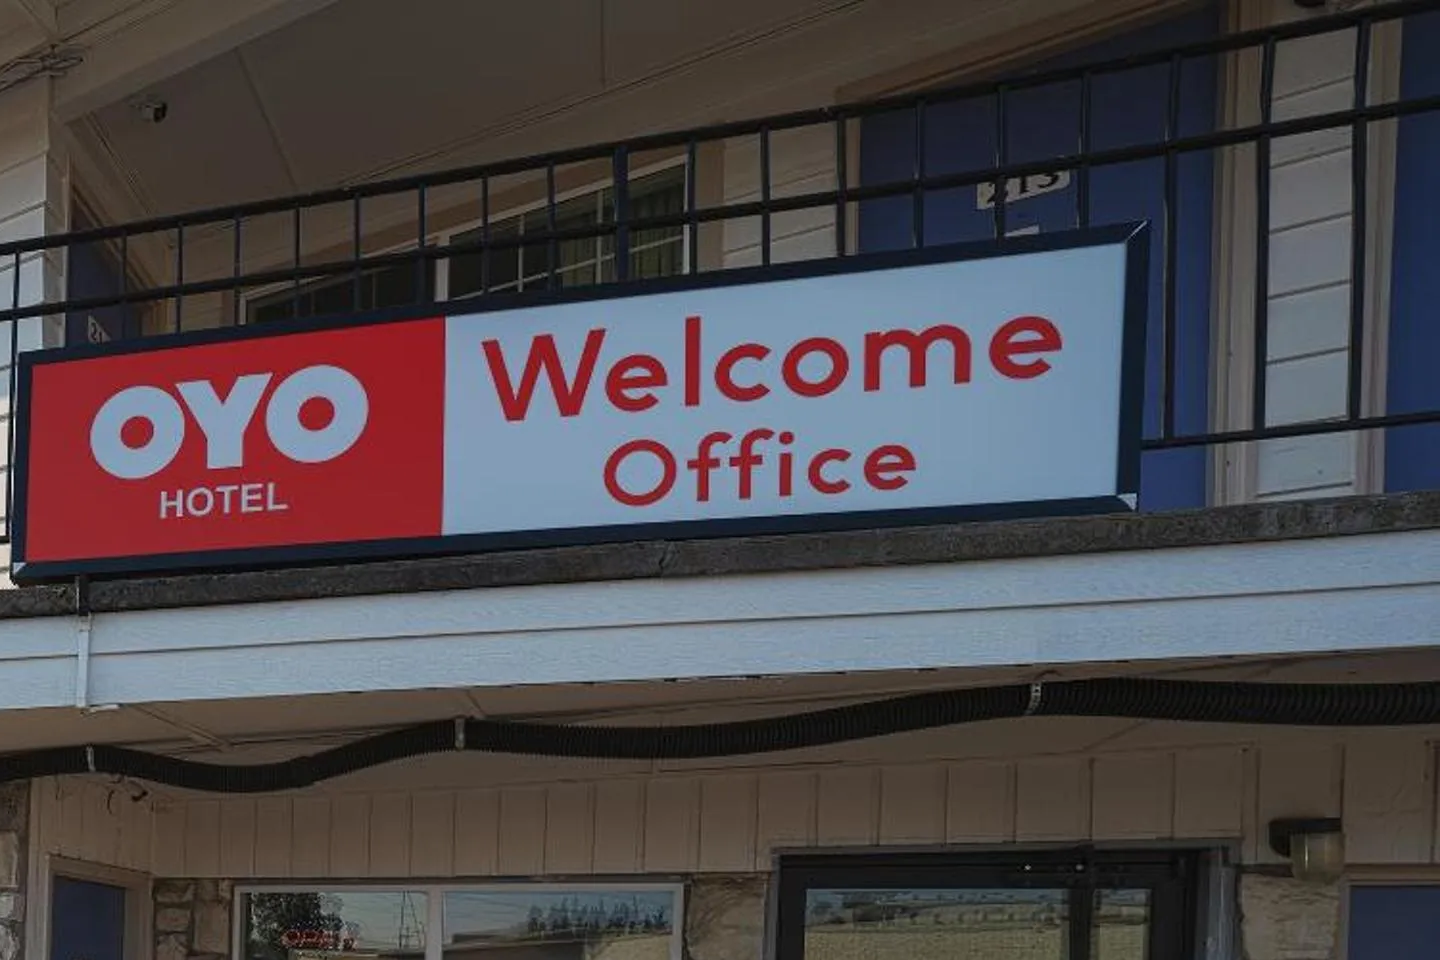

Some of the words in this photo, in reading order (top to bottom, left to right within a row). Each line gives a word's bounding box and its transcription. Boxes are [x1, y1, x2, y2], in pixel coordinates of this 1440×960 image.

[481, 315, 1063, 422] Welcome
[89, 364, 369, 480] OYO
[602, 428, 917, 507] Office
[159, 482, 288, 519] HOTEL
